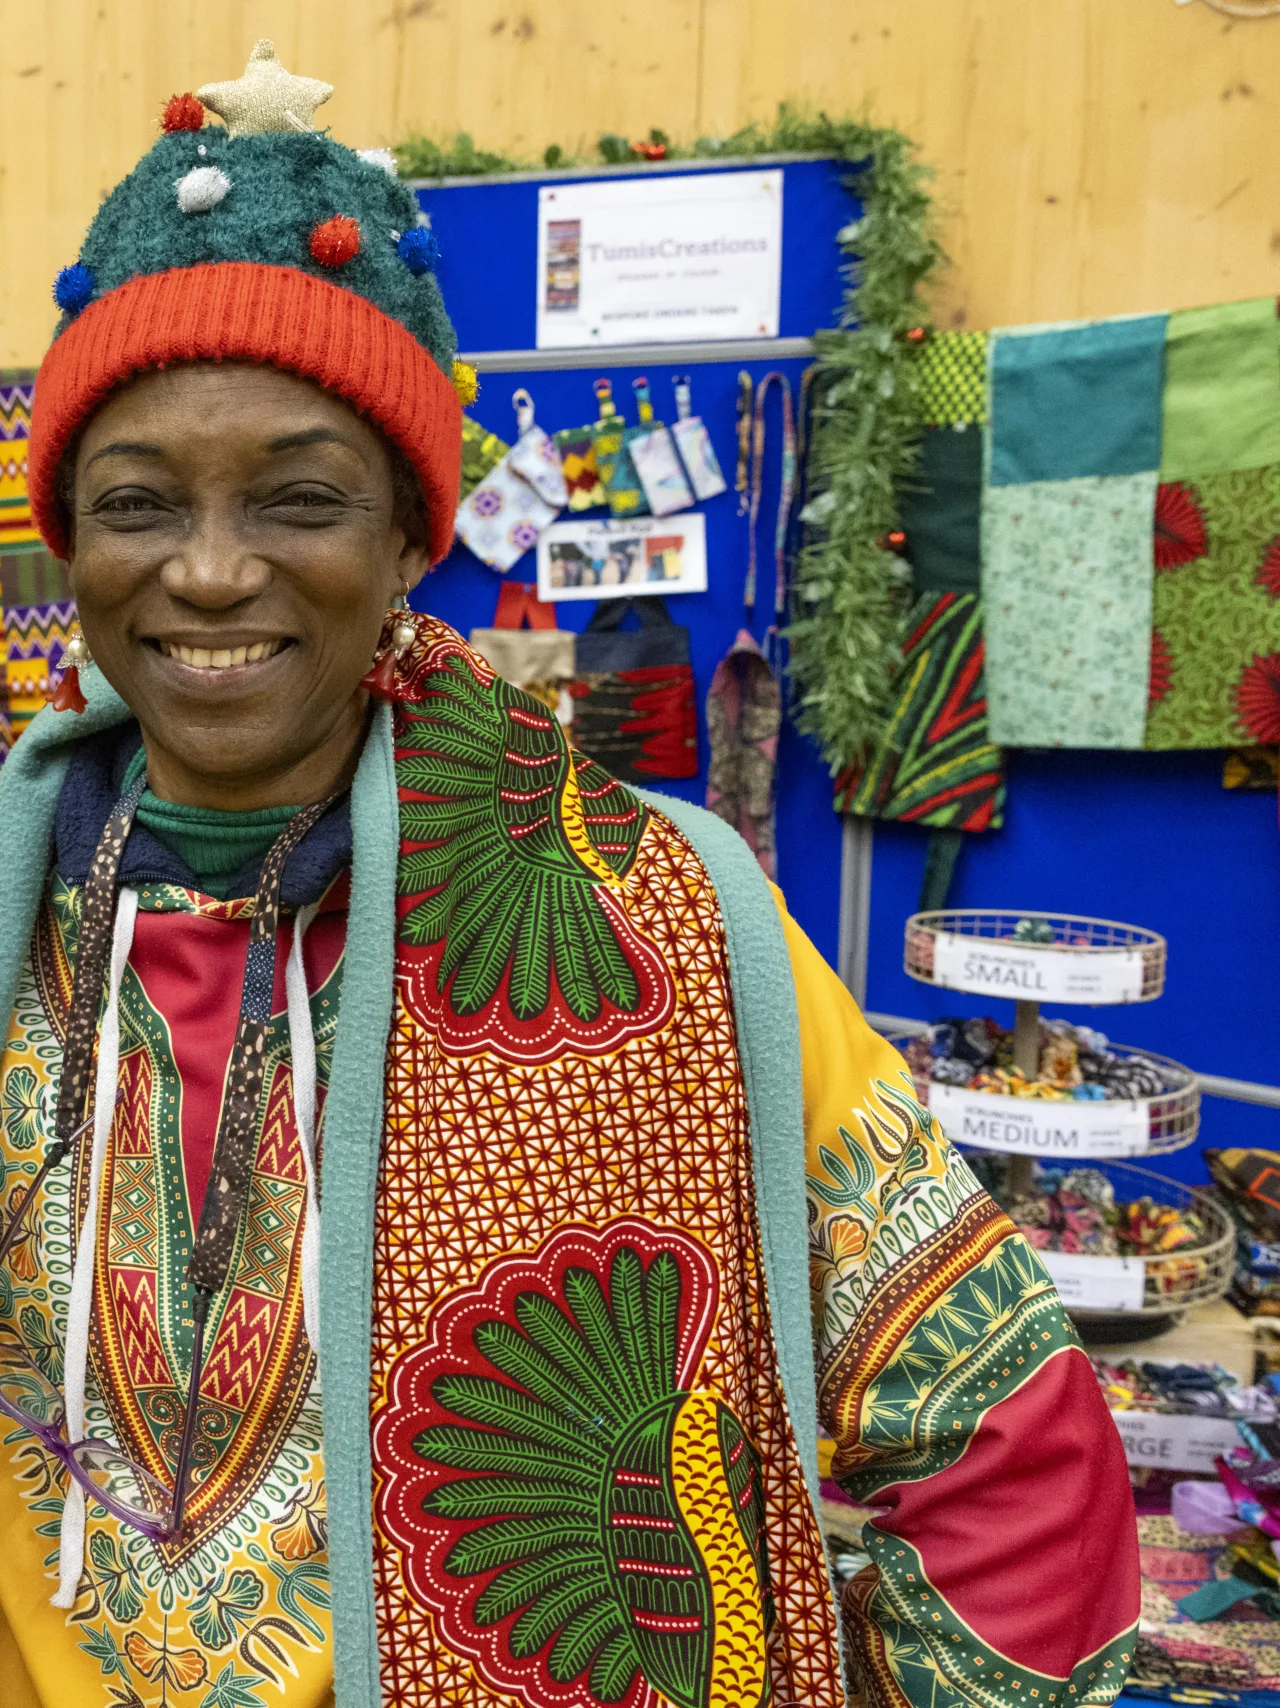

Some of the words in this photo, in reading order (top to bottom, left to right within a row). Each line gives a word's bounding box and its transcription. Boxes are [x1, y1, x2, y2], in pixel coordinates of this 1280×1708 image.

[963, 961, 1048, 991] SMALL
[962, 1117, 1079, 1149] MEDIUM
[1122, 1435, 1174, 1458] RGE
